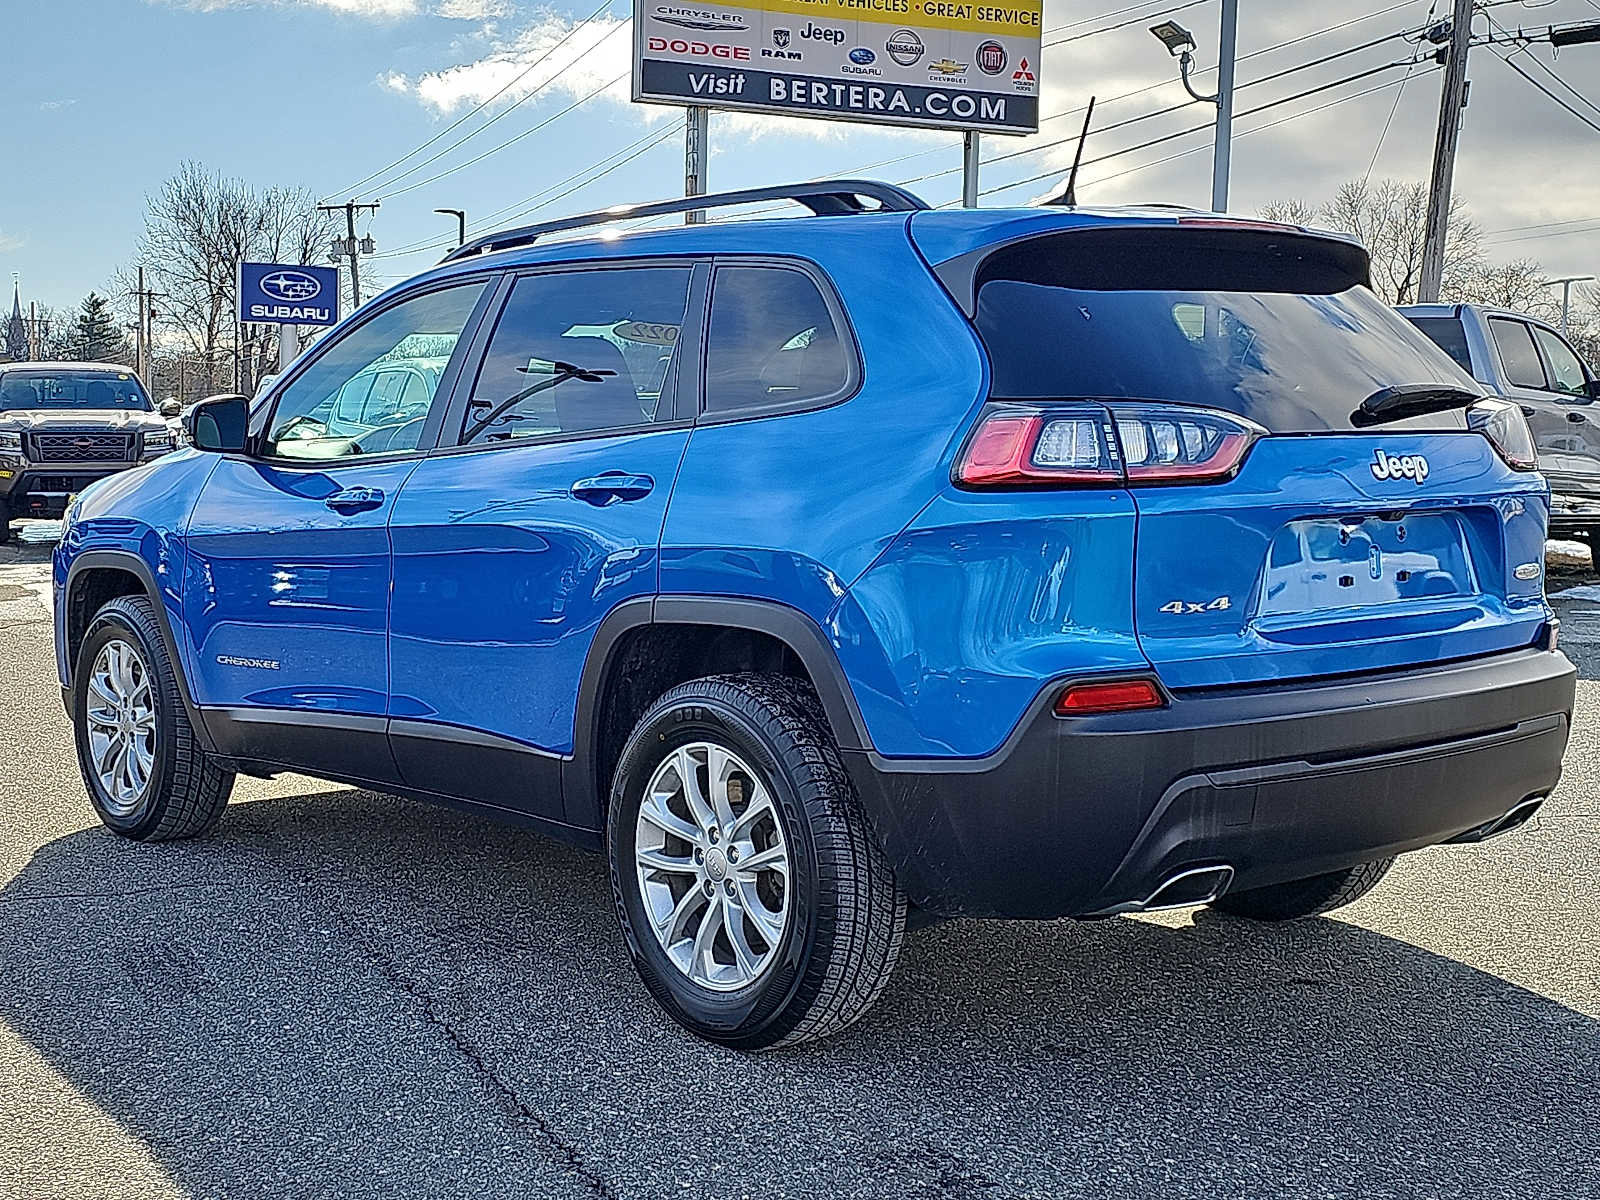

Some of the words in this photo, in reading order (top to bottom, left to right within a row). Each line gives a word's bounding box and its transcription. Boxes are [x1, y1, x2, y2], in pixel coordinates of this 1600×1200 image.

[656, 7, 743, 22] CHRYSLER
[923, 1, 973, 19] GREAT
[977, 6, 1039, 26] SERVICE
[800, 22, 845, 45] Jeep
[648, 37, 751, 60] DODGE
[761, 49, 802, 60] RAM
[889, 43, 921, 53] NISSAN
[983, 50, 1002, 67] FIAT
[841, 66, 882, 76] SUBARU
[929, 75, 967, 84] CHEVROLET
[688, 73, 746, 94] Visit
[770, 77, 1006, 121] BERTERA.COM
[250, 304, 329, 321] SUBARU
[1371, 449, 1430, 484] Jeep
[1159, 596, 1232, 614] 4x4
[216, 655, 280, 670] CHEROKEE
